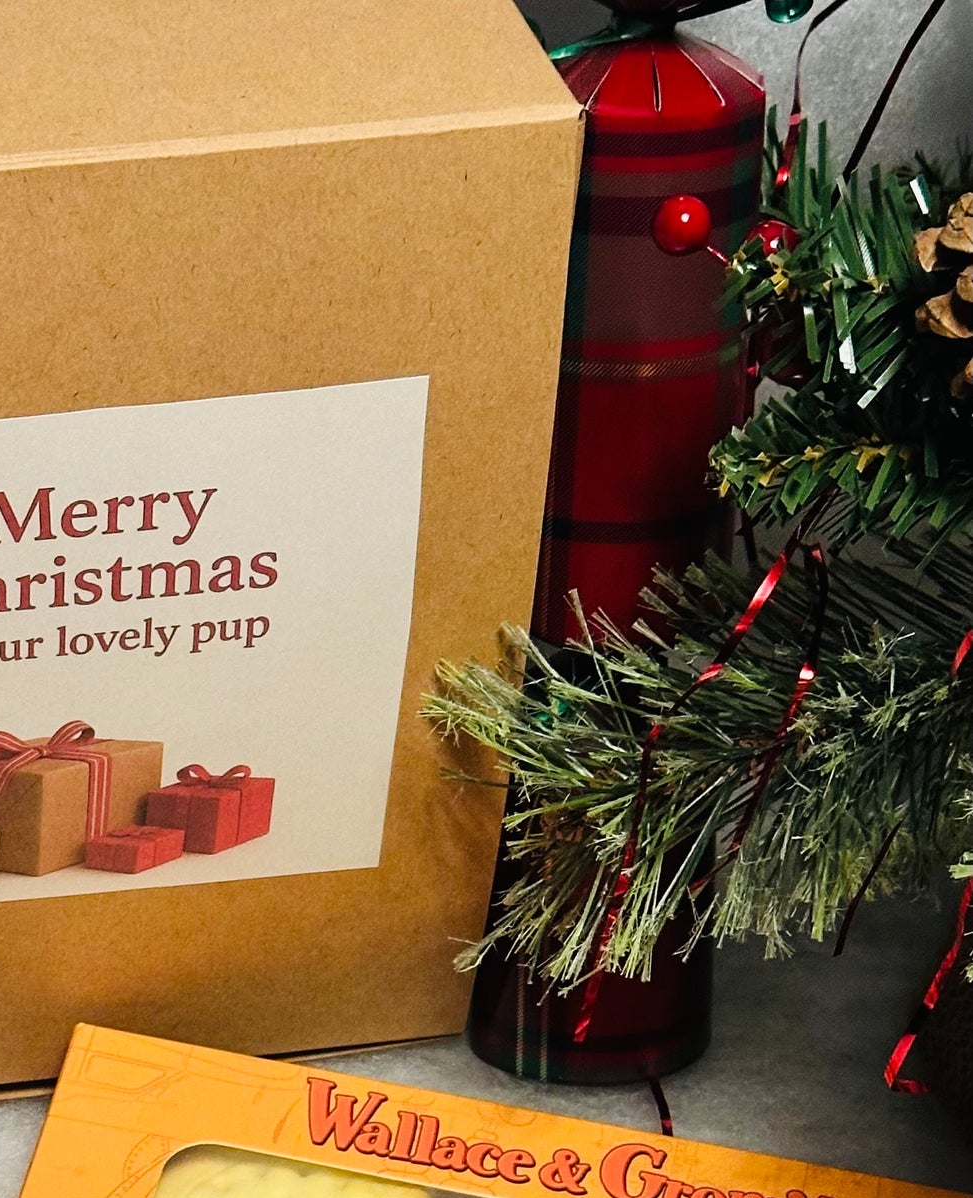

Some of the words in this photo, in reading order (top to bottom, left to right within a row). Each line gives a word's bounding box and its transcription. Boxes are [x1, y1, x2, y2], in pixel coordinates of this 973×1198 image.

[56, 617, 179, 656] lovely
[190, 614, 270, 653] pup
[307, 1076, 535, 1184] Wallace
[538, 1148, 591, 1195] &
